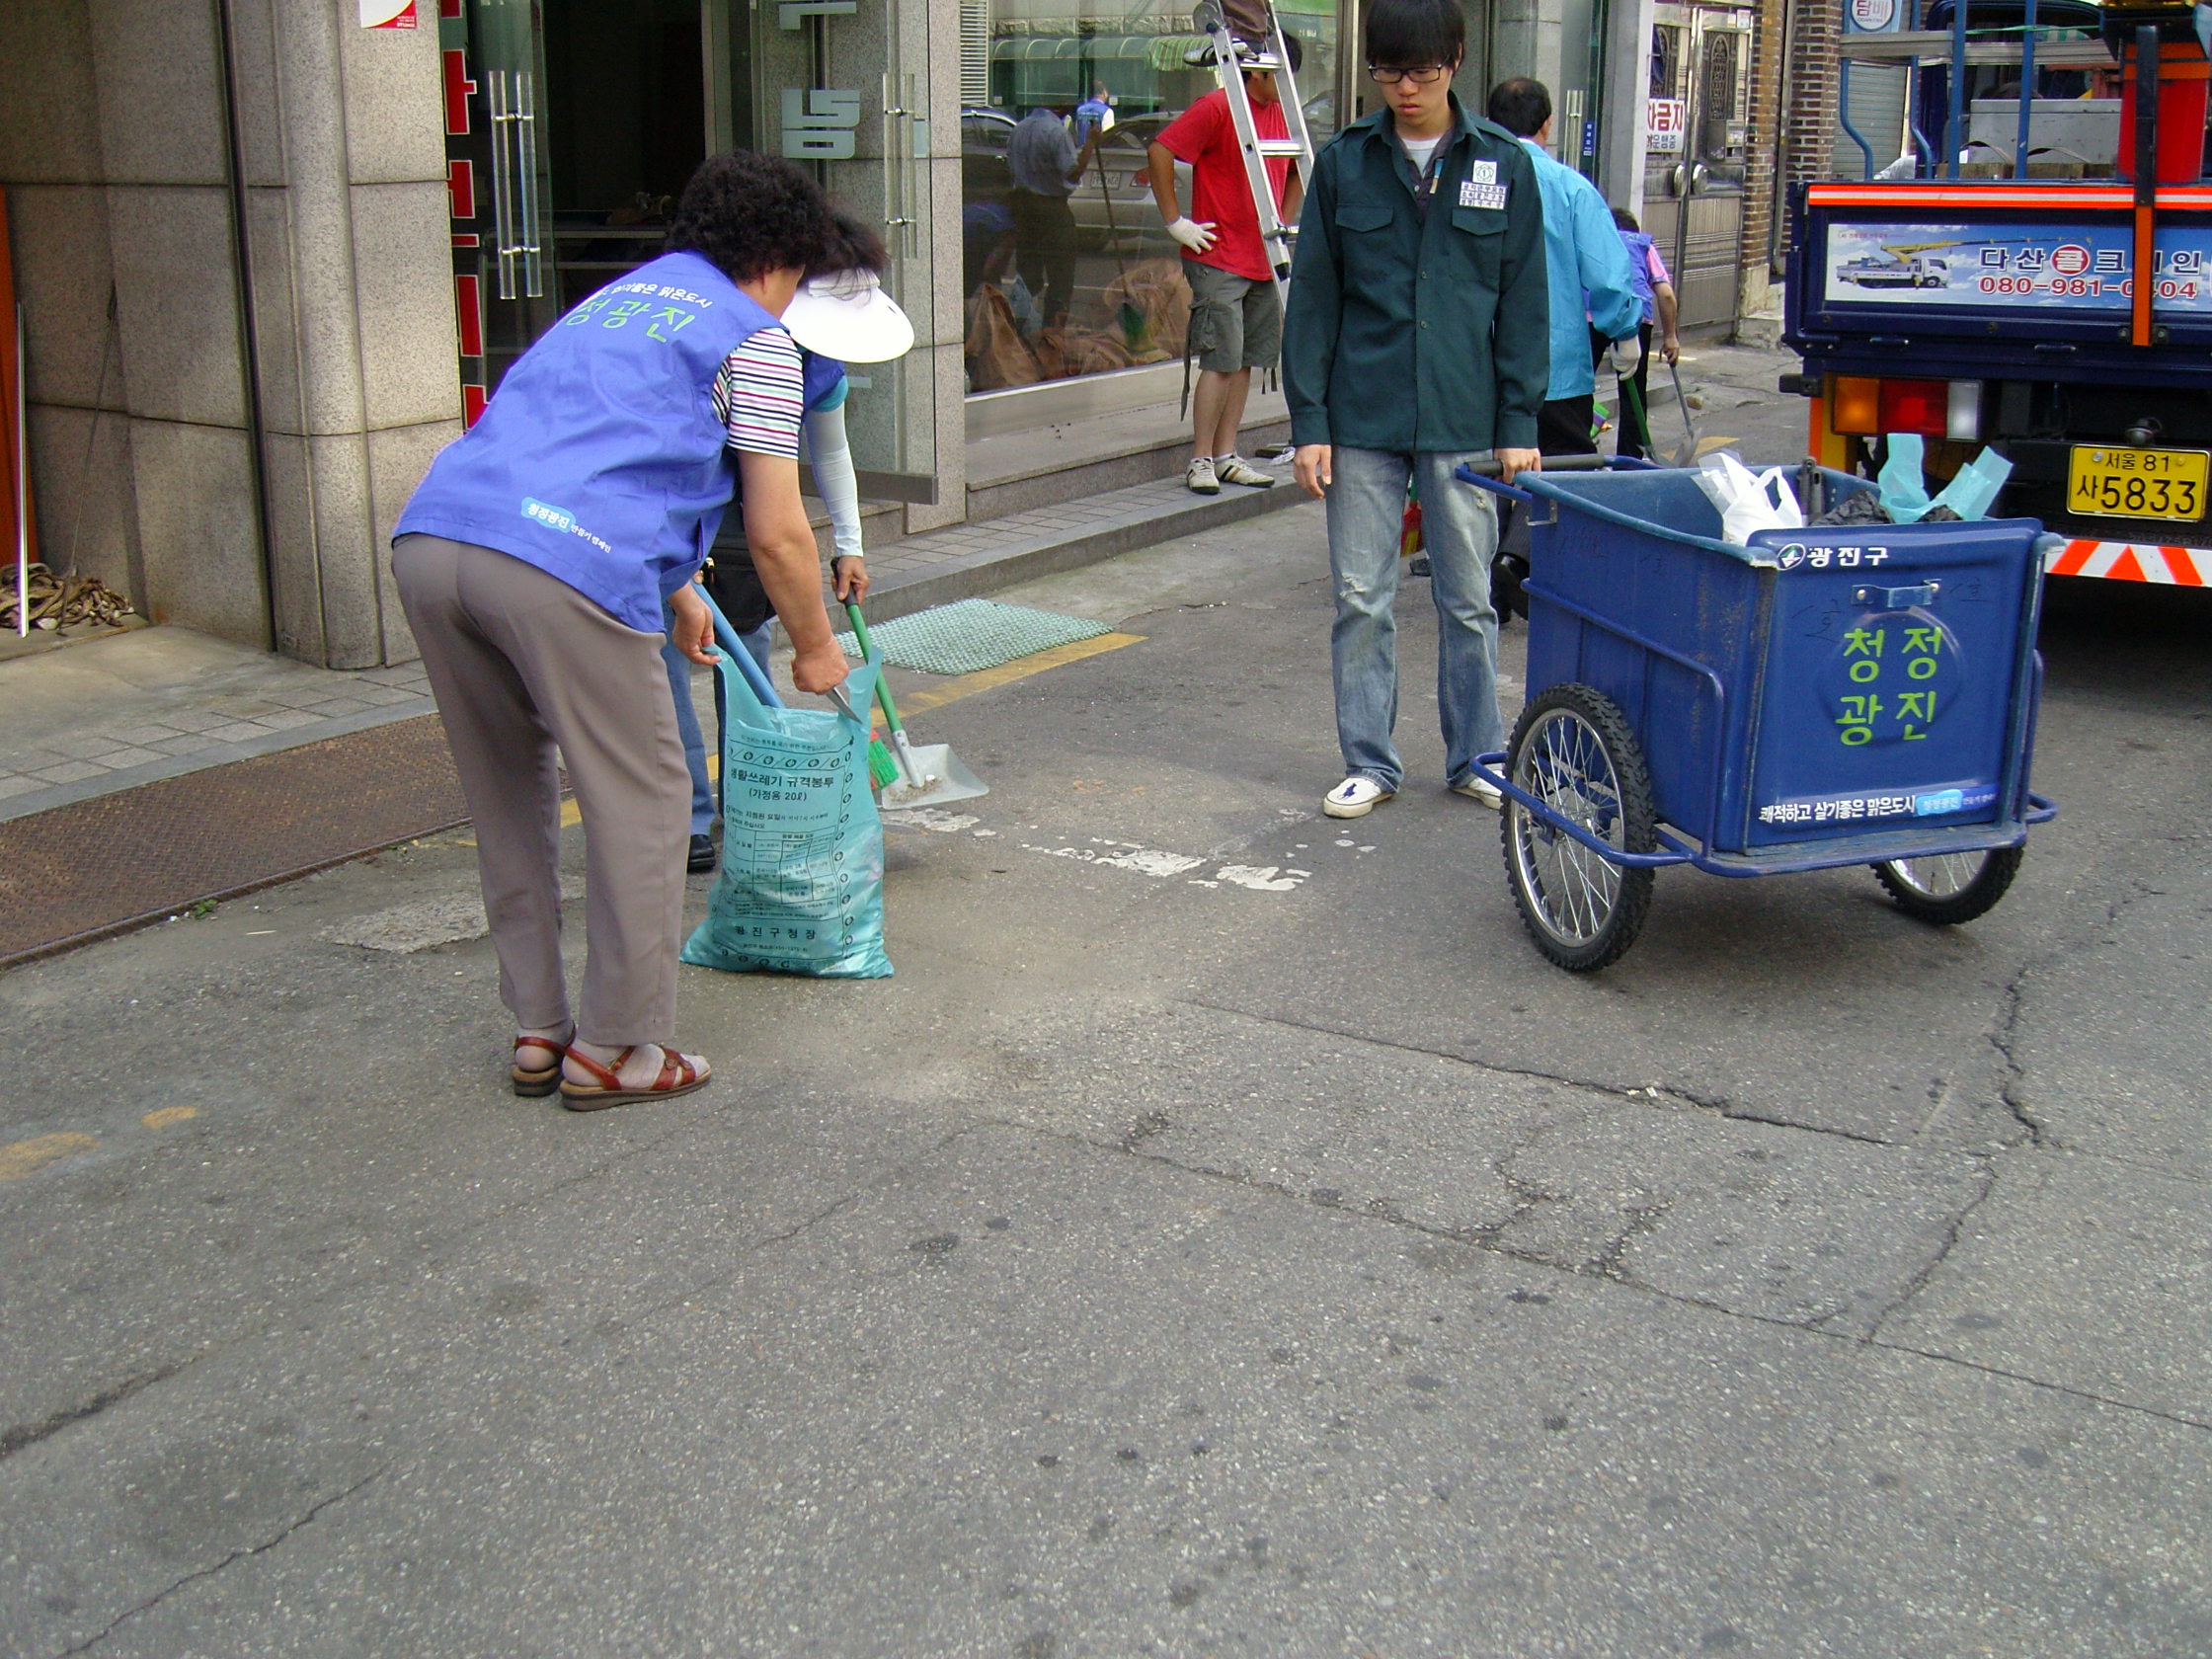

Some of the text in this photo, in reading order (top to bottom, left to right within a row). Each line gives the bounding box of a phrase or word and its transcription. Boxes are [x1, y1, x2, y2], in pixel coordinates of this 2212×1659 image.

[1979, 244, 2202, 276] 다산콜크인
[658, 285, 713, 308] 맑은도시
[1979, 276, 2197, 299] 080-981-004
[2105, 452, 2170, 472] 서울 81
[527, 503, 571, 529] 청정광진
[1806, 546, 1889, 568] 광진구
[1844, 625, 1943, 683] 청정
[1835, 690, 1937, 746] 광진
[731, 767, 834, 788] 생활쓰레기 규격봉투
[749, 788, 780, 801] (가정용
[1758, 802, 1811, 824] 쾌적하고
[1814, 798, 1864, 821] 살기좋은
[1866, 794, 1916, 817] 맑은도시
